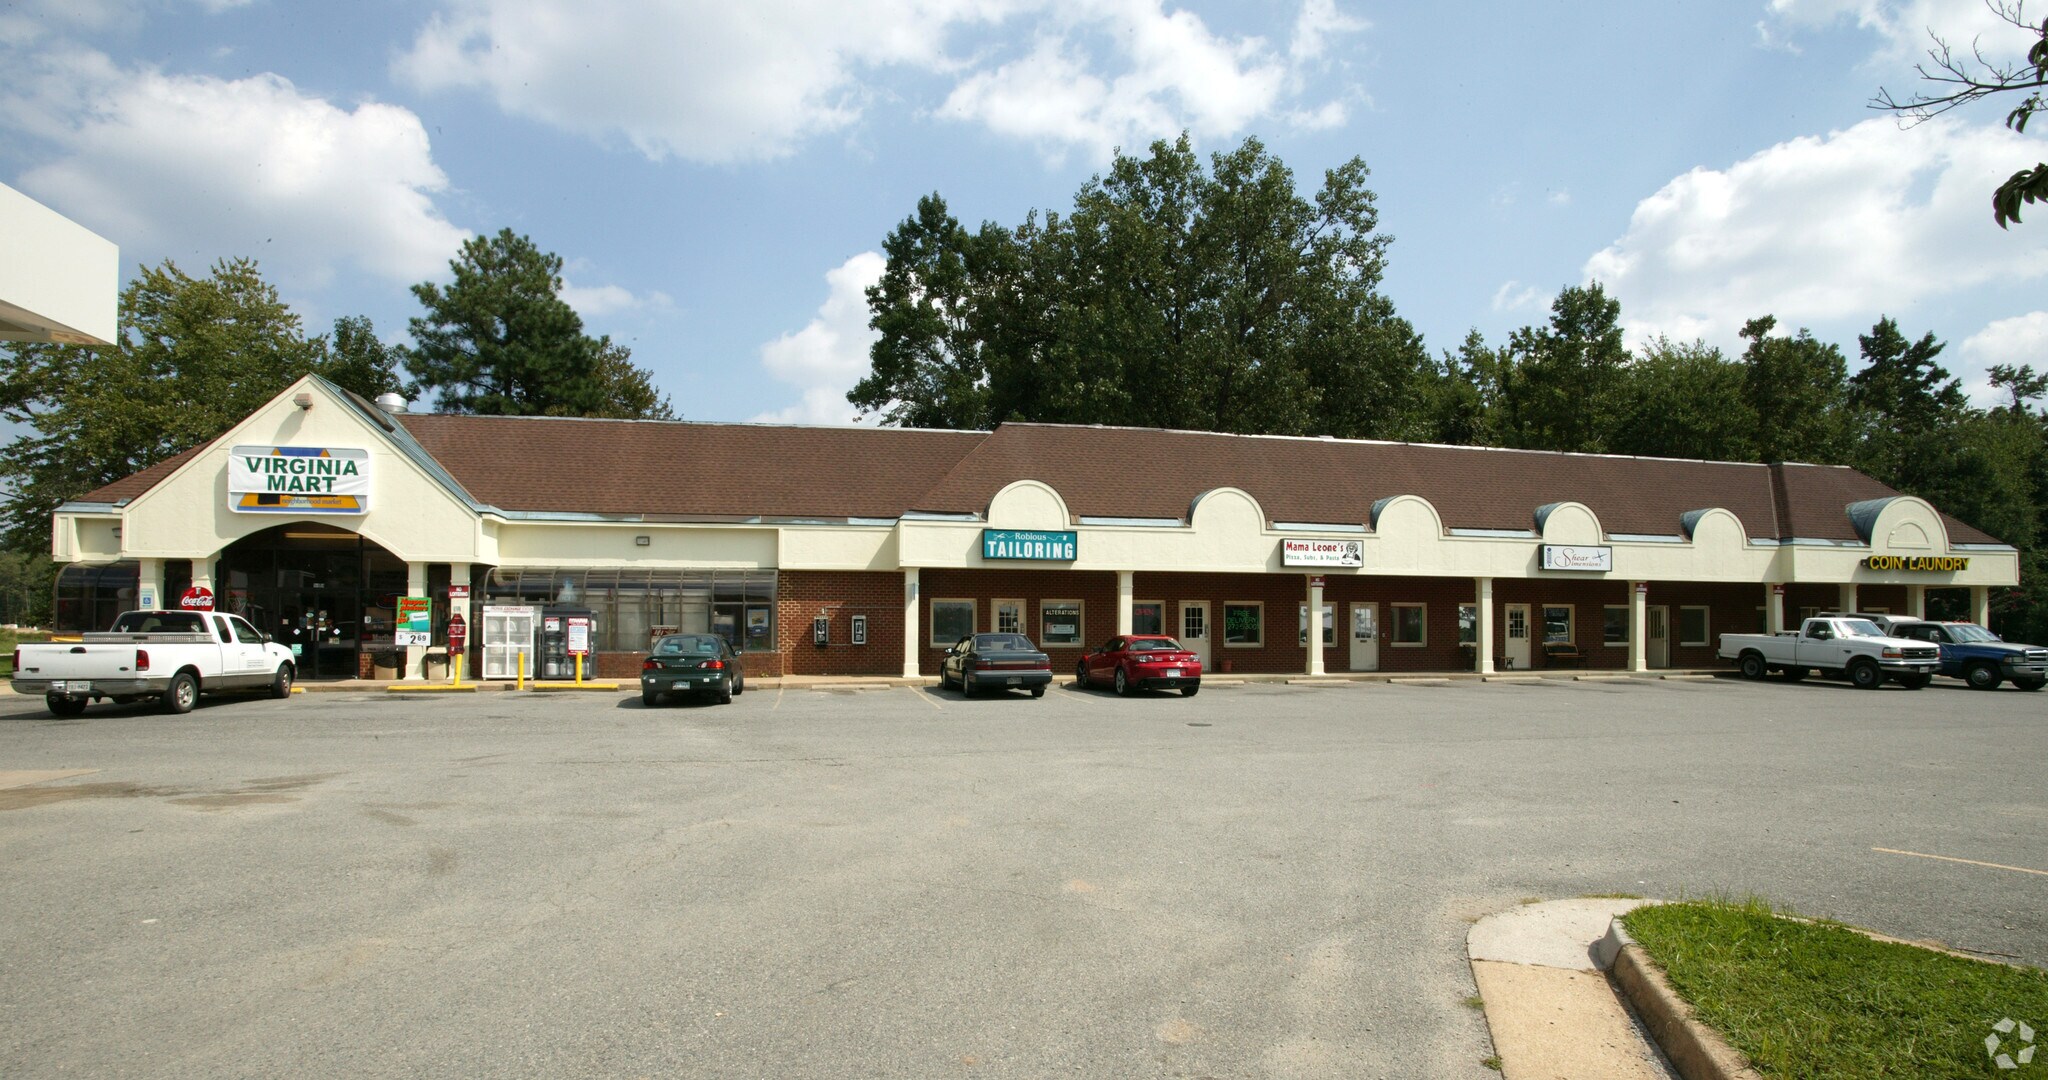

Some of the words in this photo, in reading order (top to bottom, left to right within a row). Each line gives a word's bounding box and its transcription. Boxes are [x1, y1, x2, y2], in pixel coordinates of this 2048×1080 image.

[245, 457, 359, 476] VIRGINIA
[267, 475, 337, 492] MART
[281, 497, 321, 505] neighborhood
[1015, 532, 1047, 540] Robious
[987, 541, 1074, 559] TAILORING
[1286, 541, 1309, 552] Mama
[1312, 542, 1344, 552] Leone's
[1560, 548, 1589, 564] Shear
[1869, 555, 1902, 570] COIN
[1909, 556, 1970, 571] LAUNDRY
[181, 595, 214, 606] Coca-Cola
[1135, 608, 1154, 616] OPEN
[1232, 609, 1250, 617] FREE
[1227, 616, 1257, 624] DELIVERY
